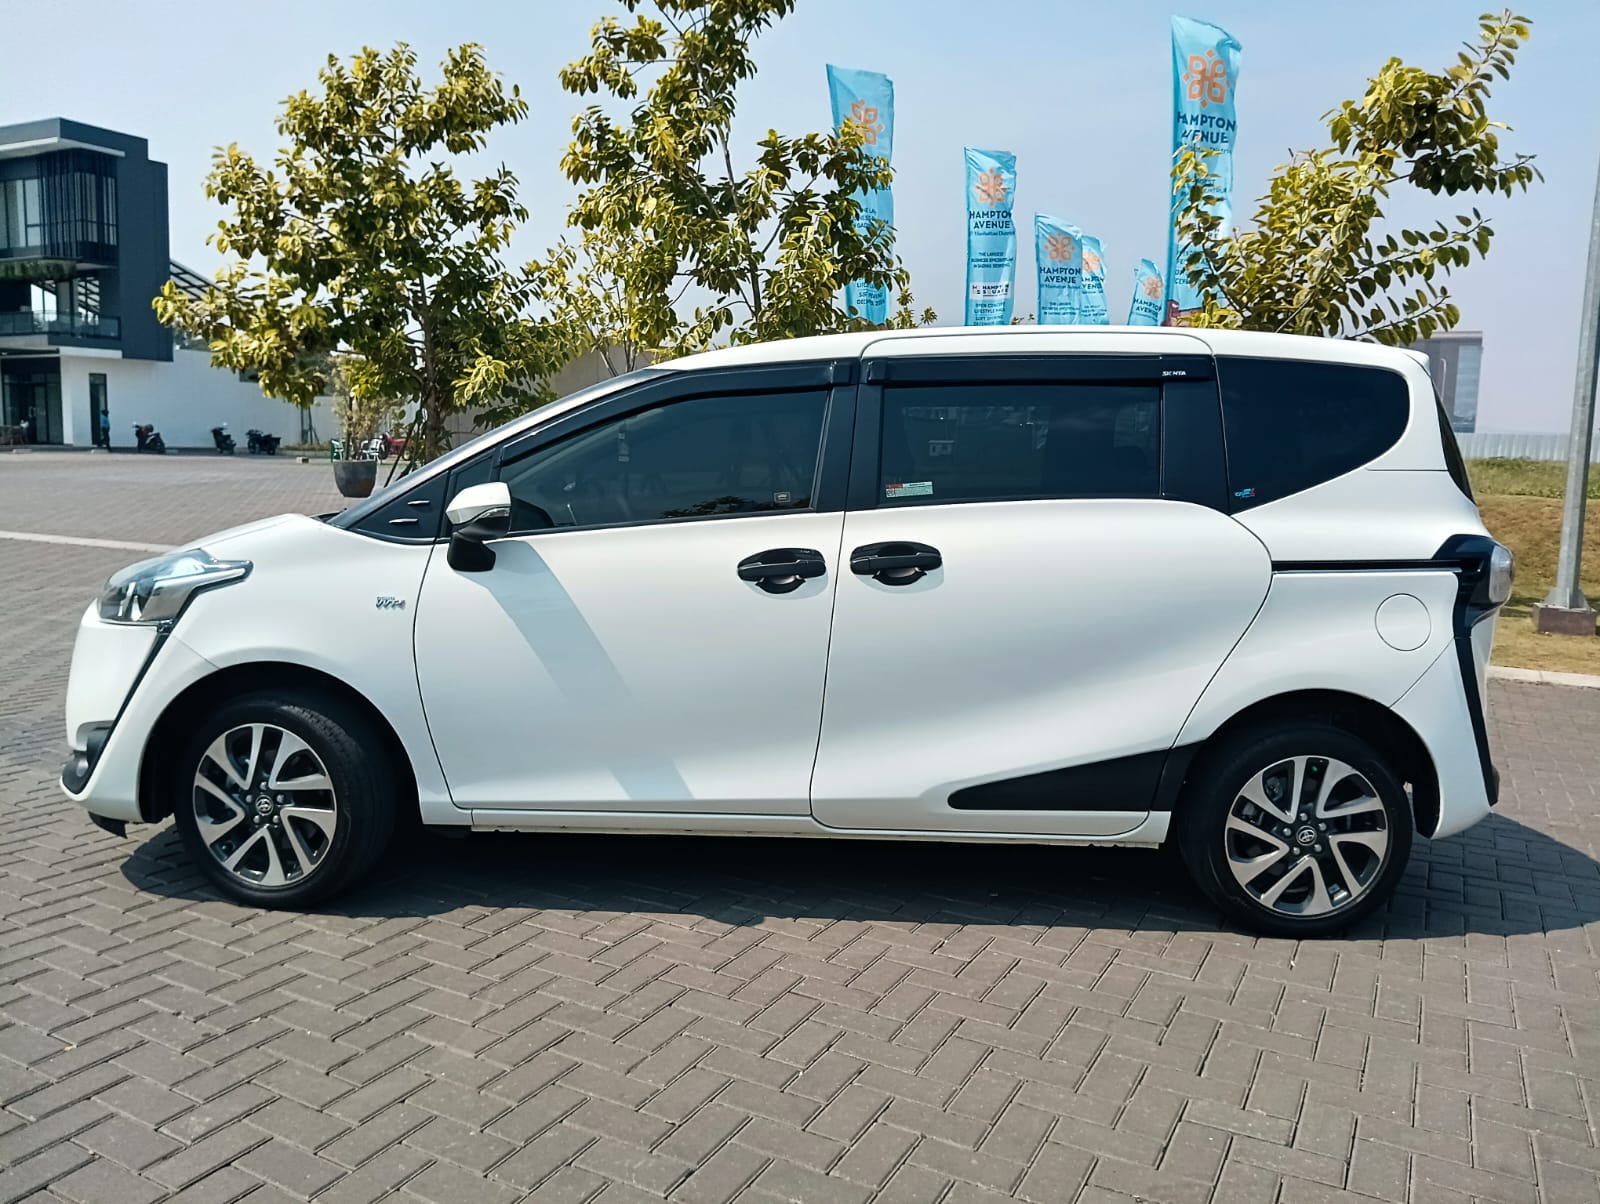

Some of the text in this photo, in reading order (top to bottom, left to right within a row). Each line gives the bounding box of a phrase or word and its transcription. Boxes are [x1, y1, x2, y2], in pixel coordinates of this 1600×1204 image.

[1176, 111, 1237, 133] HAMPTON
[974, 220, 1011, 229] AVENUE
[1039, 266, 1081, 276] HAMPTON
